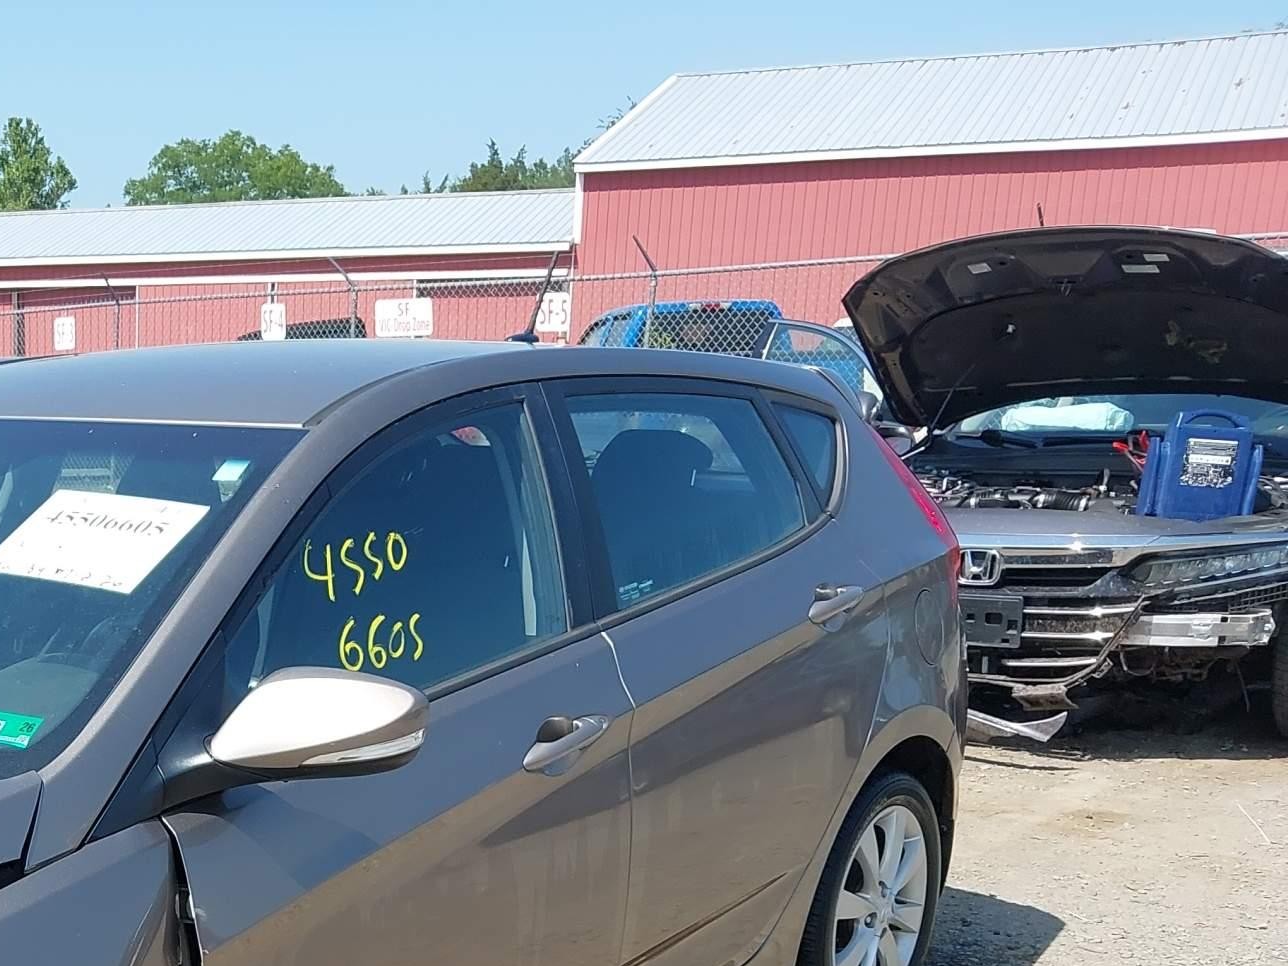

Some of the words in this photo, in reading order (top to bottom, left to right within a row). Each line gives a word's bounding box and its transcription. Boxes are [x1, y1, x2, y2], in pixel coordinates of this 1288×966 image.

[263, 310, 285, 333] SF-4
[397, 302, 410, 317] SF
[539, 299, 568, 325] SF-5
[47, 509, 171, 536] 45506605
[304, 531, 408, 602] 4550
[339, 613, 424, 671] 6605
[18, 721, 36, 733] 26
